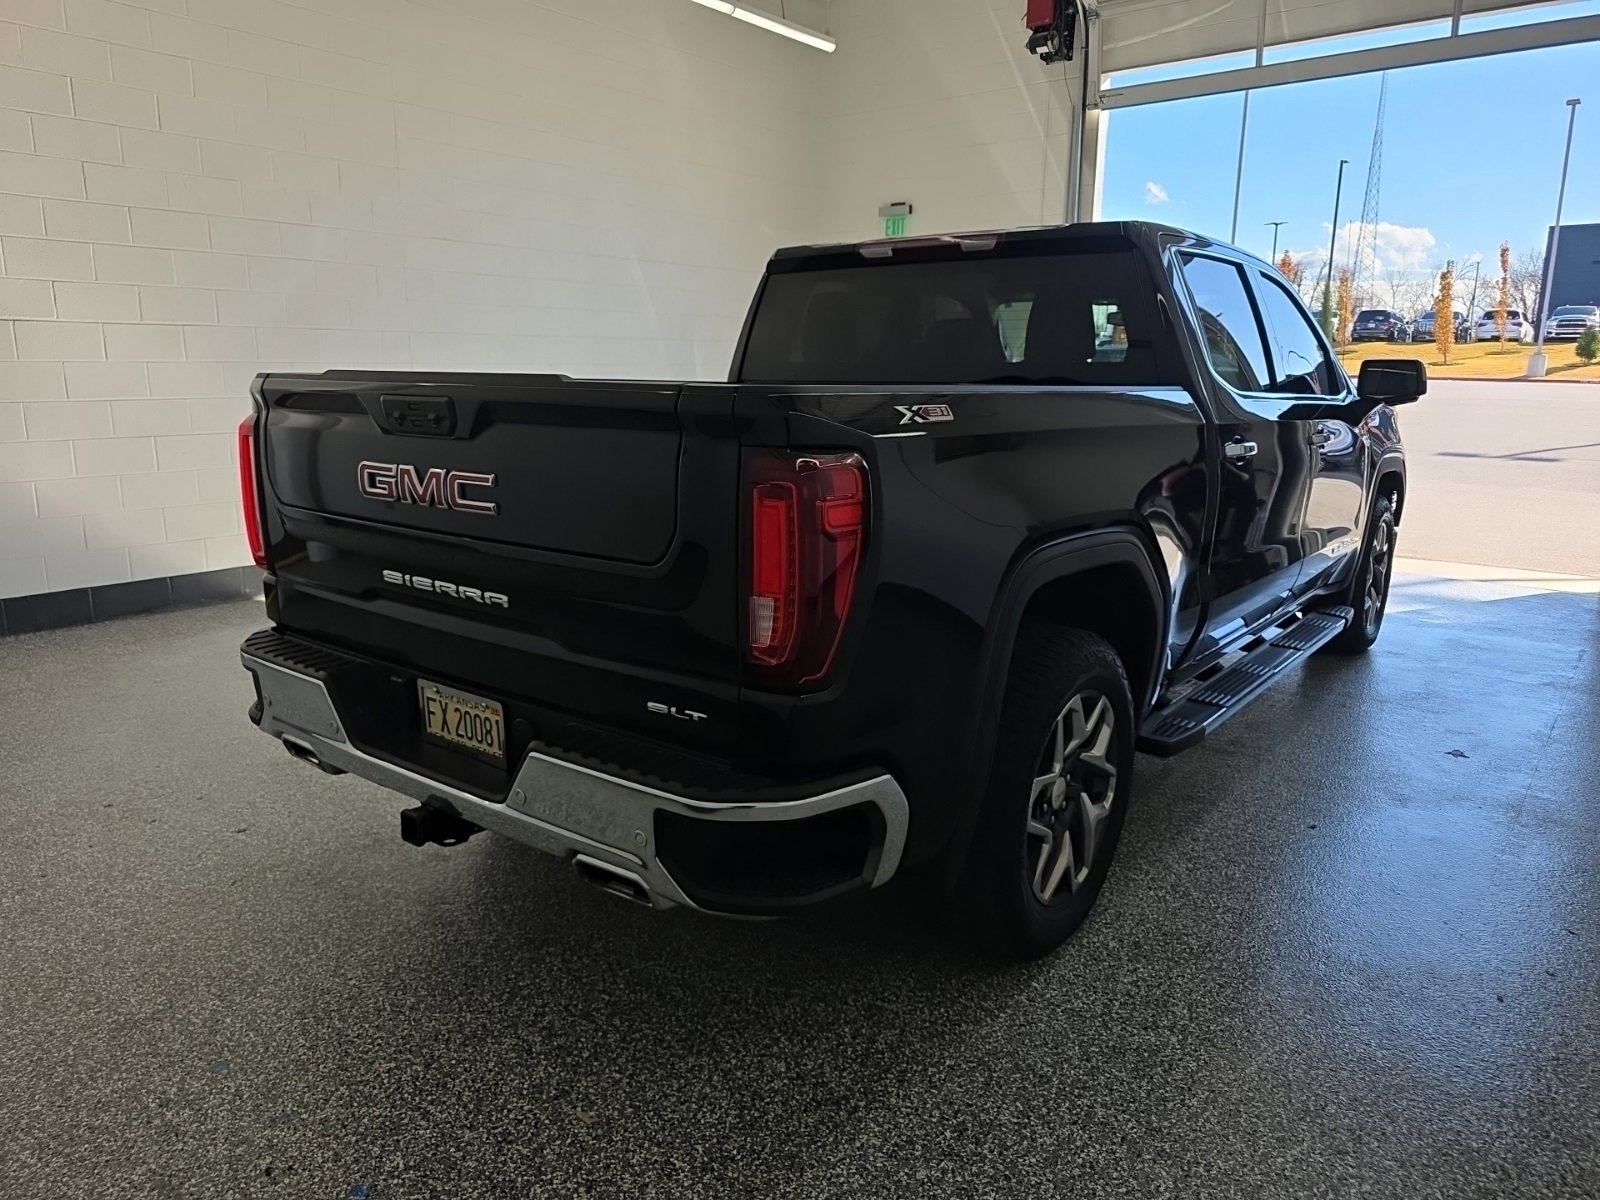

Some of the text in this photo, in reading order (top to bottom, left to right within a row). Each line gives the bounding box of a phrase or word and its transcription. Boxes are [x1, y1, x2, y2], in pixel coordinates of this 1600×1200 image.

[885, 218, 905, 237] EXIT
[893, 404, 954, 425] X31
[358, 461, 498, 516] GMC
[382, 569, 509, 608] SIERRA
[647, 701, 708, 720] SLT
